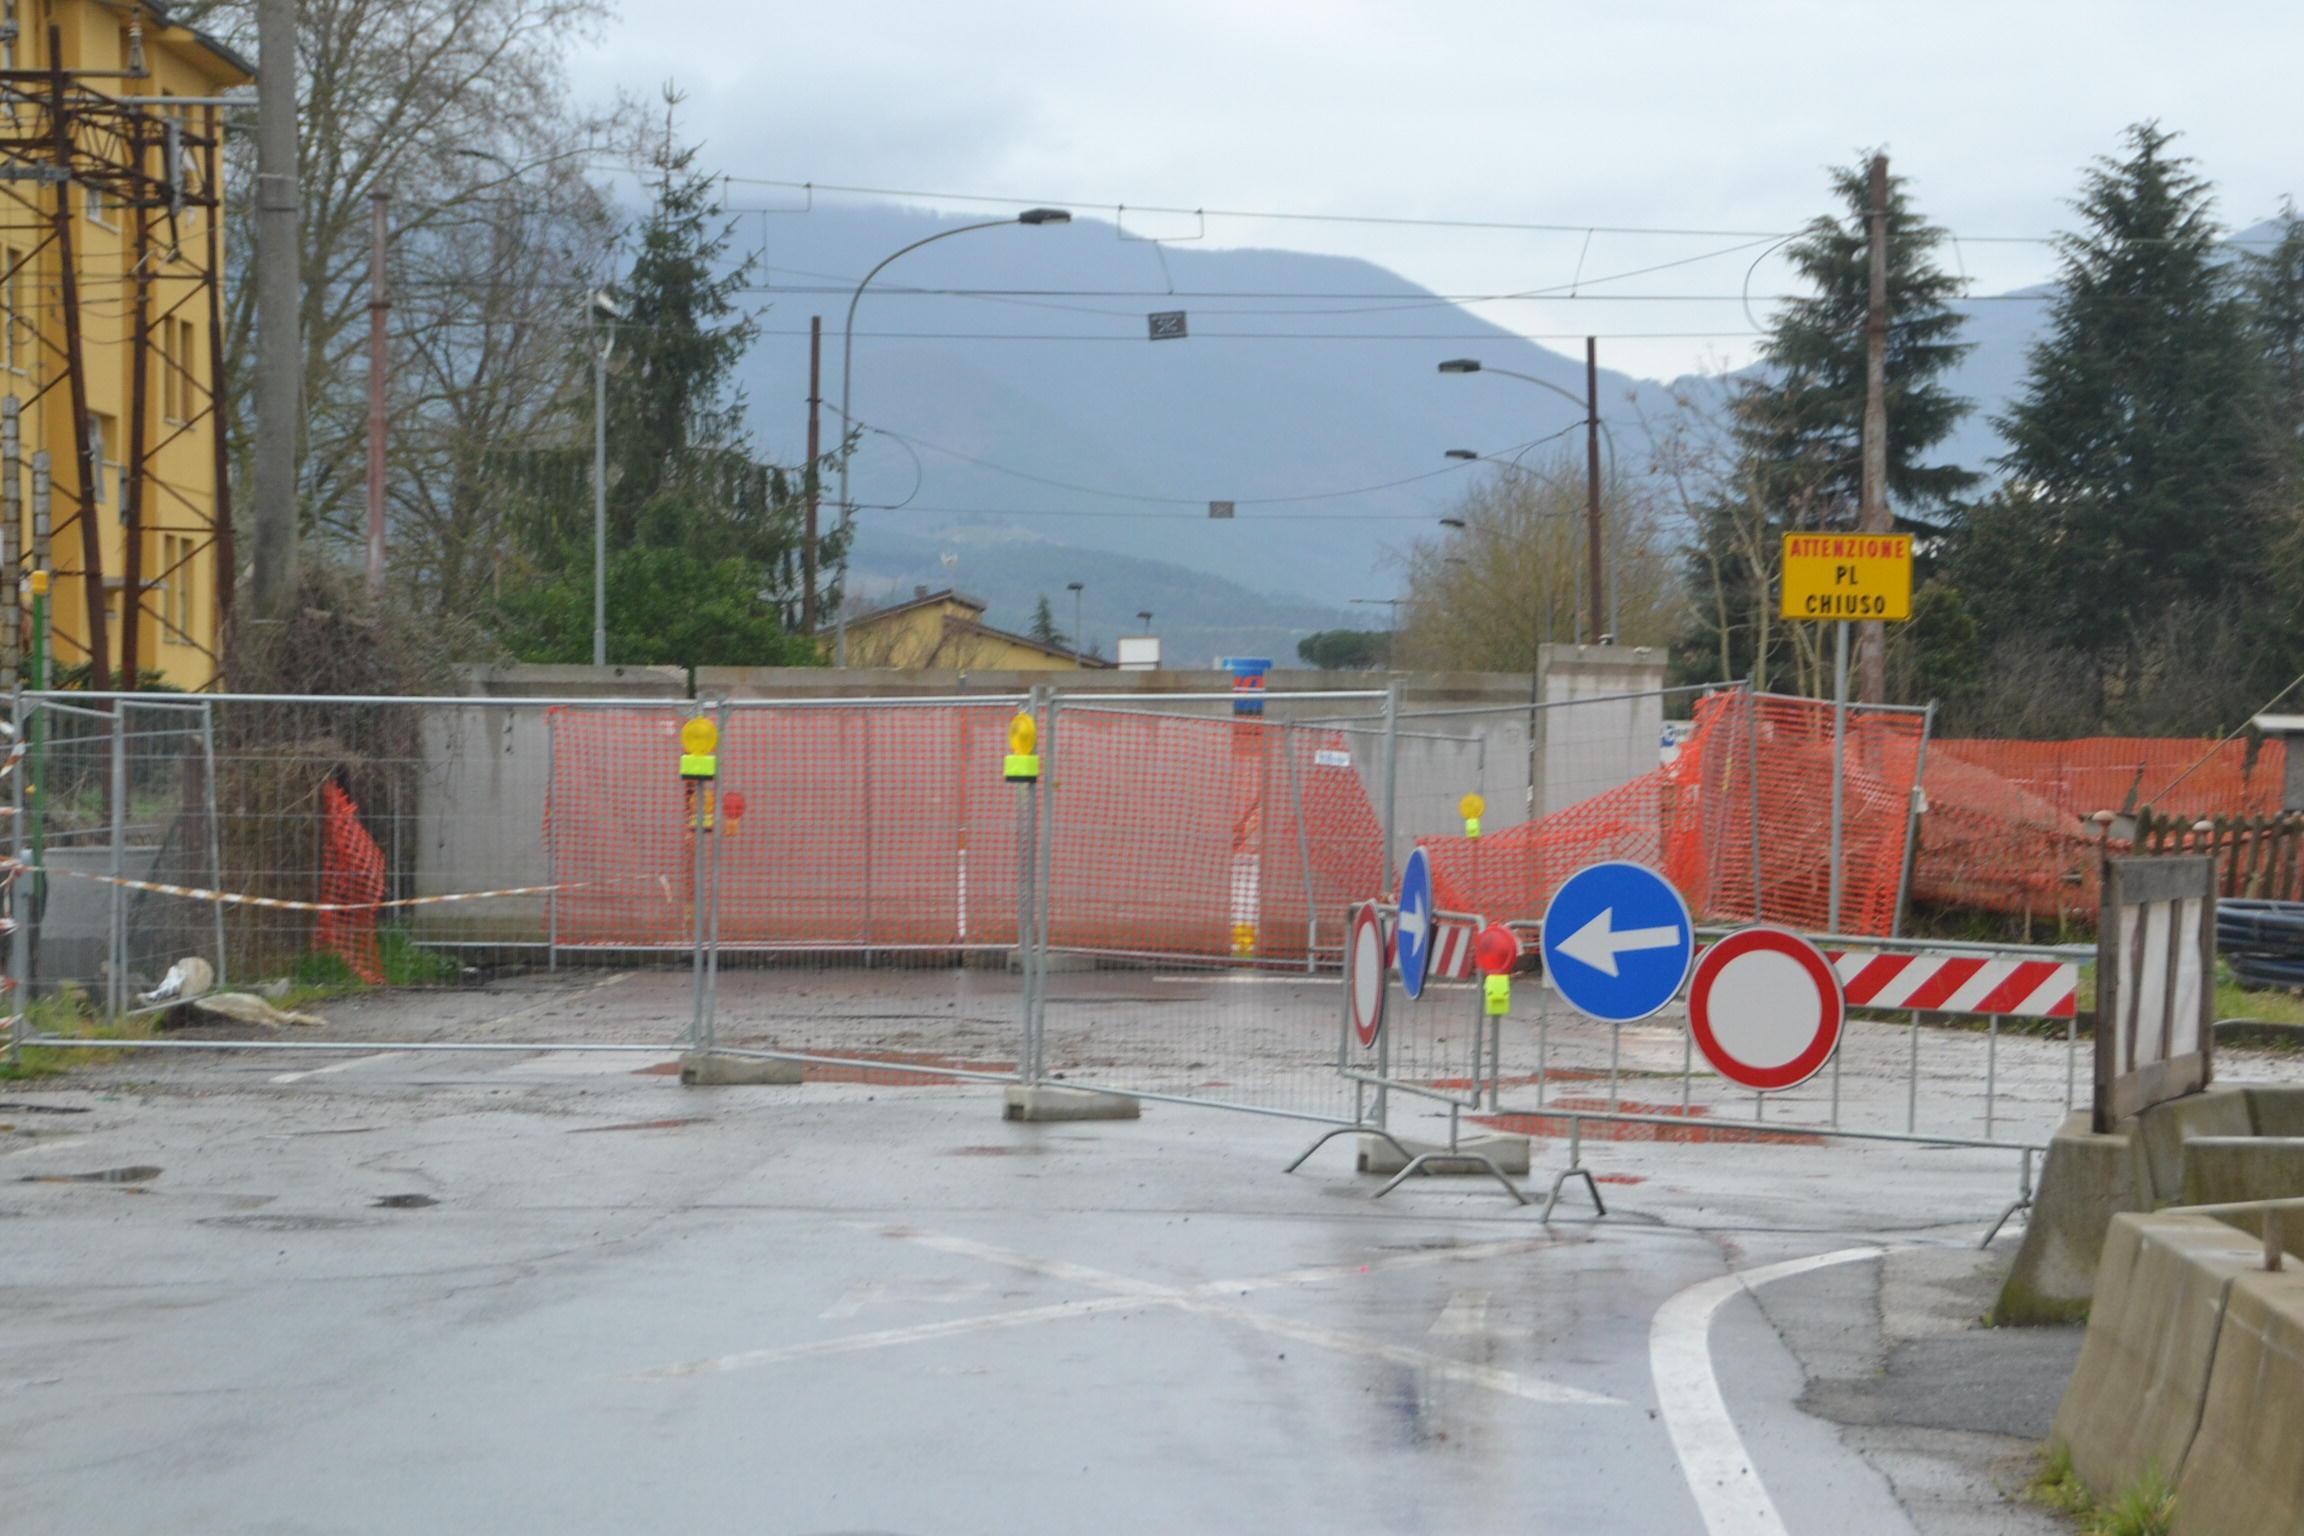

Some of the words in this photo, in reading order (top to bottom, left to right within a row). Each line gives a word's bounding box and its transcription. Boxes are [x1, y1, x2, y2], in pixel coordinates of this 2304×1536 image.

[1790, 539, 1905, 559] ATTENZIONE
[1835, 565, 1858, 585] PL
[1805, 594, 1885, 614] CHIUSO
